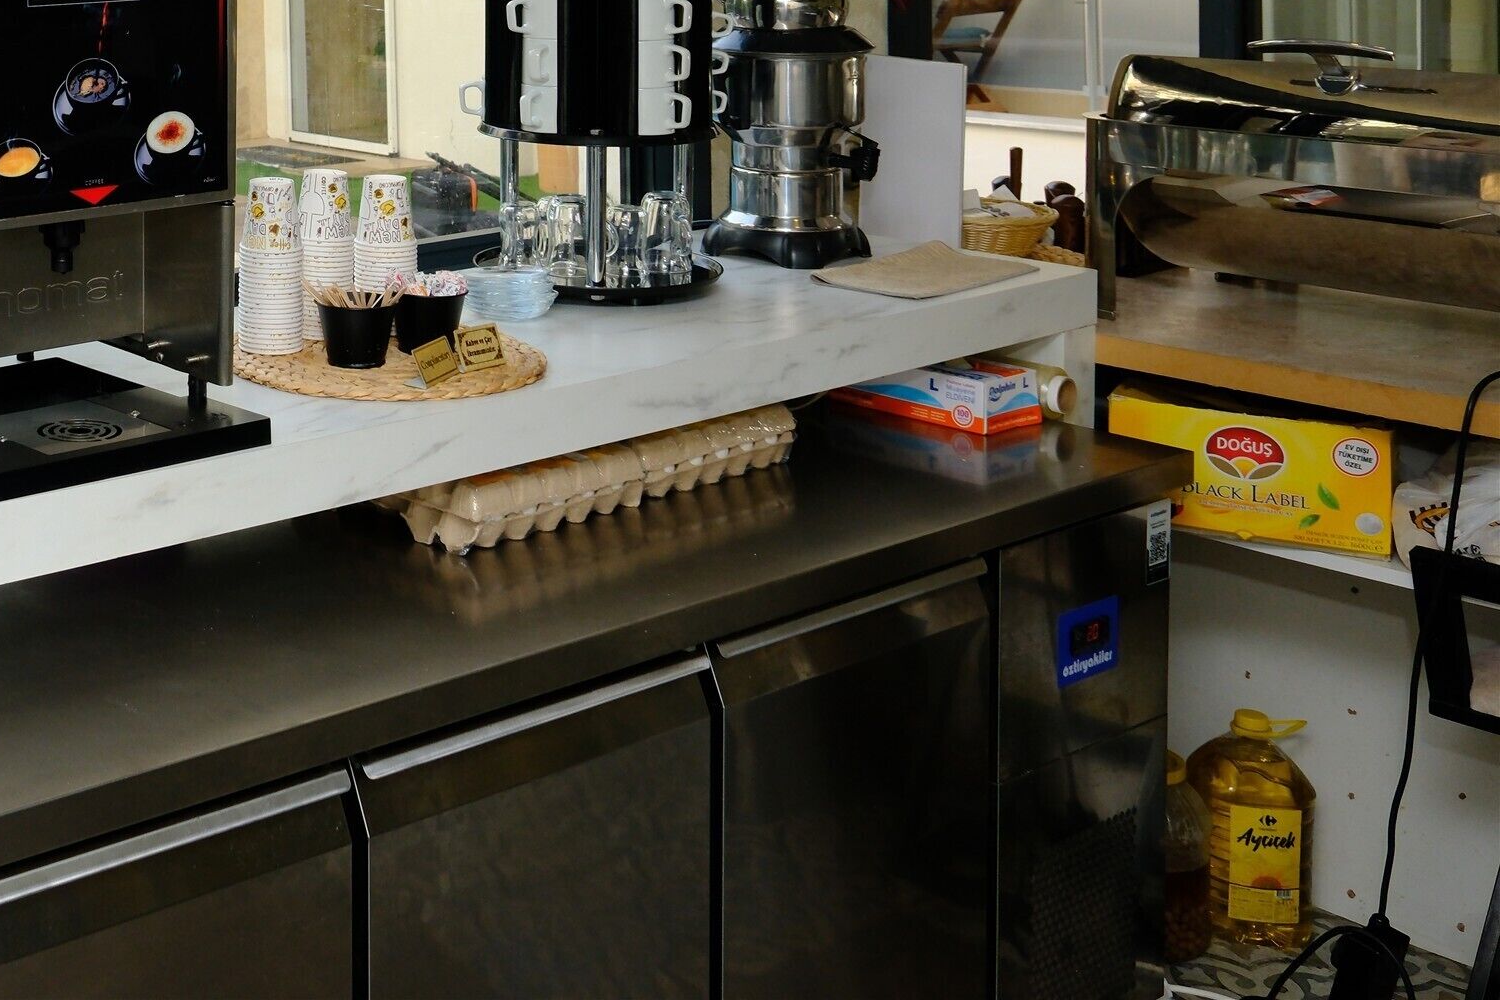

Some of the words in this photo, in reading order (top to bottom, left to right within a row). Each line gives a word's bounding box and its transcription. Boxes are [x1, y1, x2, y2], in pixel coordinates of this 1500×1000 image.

[930, 378, 939, 391] L
[1023, 377, 1029, 388] L
[1216, 437, 1273, 457] DOĞUŞ
[1252, 484, 1311, 509] LABEL
[1236, 828, 1296, 852] Ayçiçek
